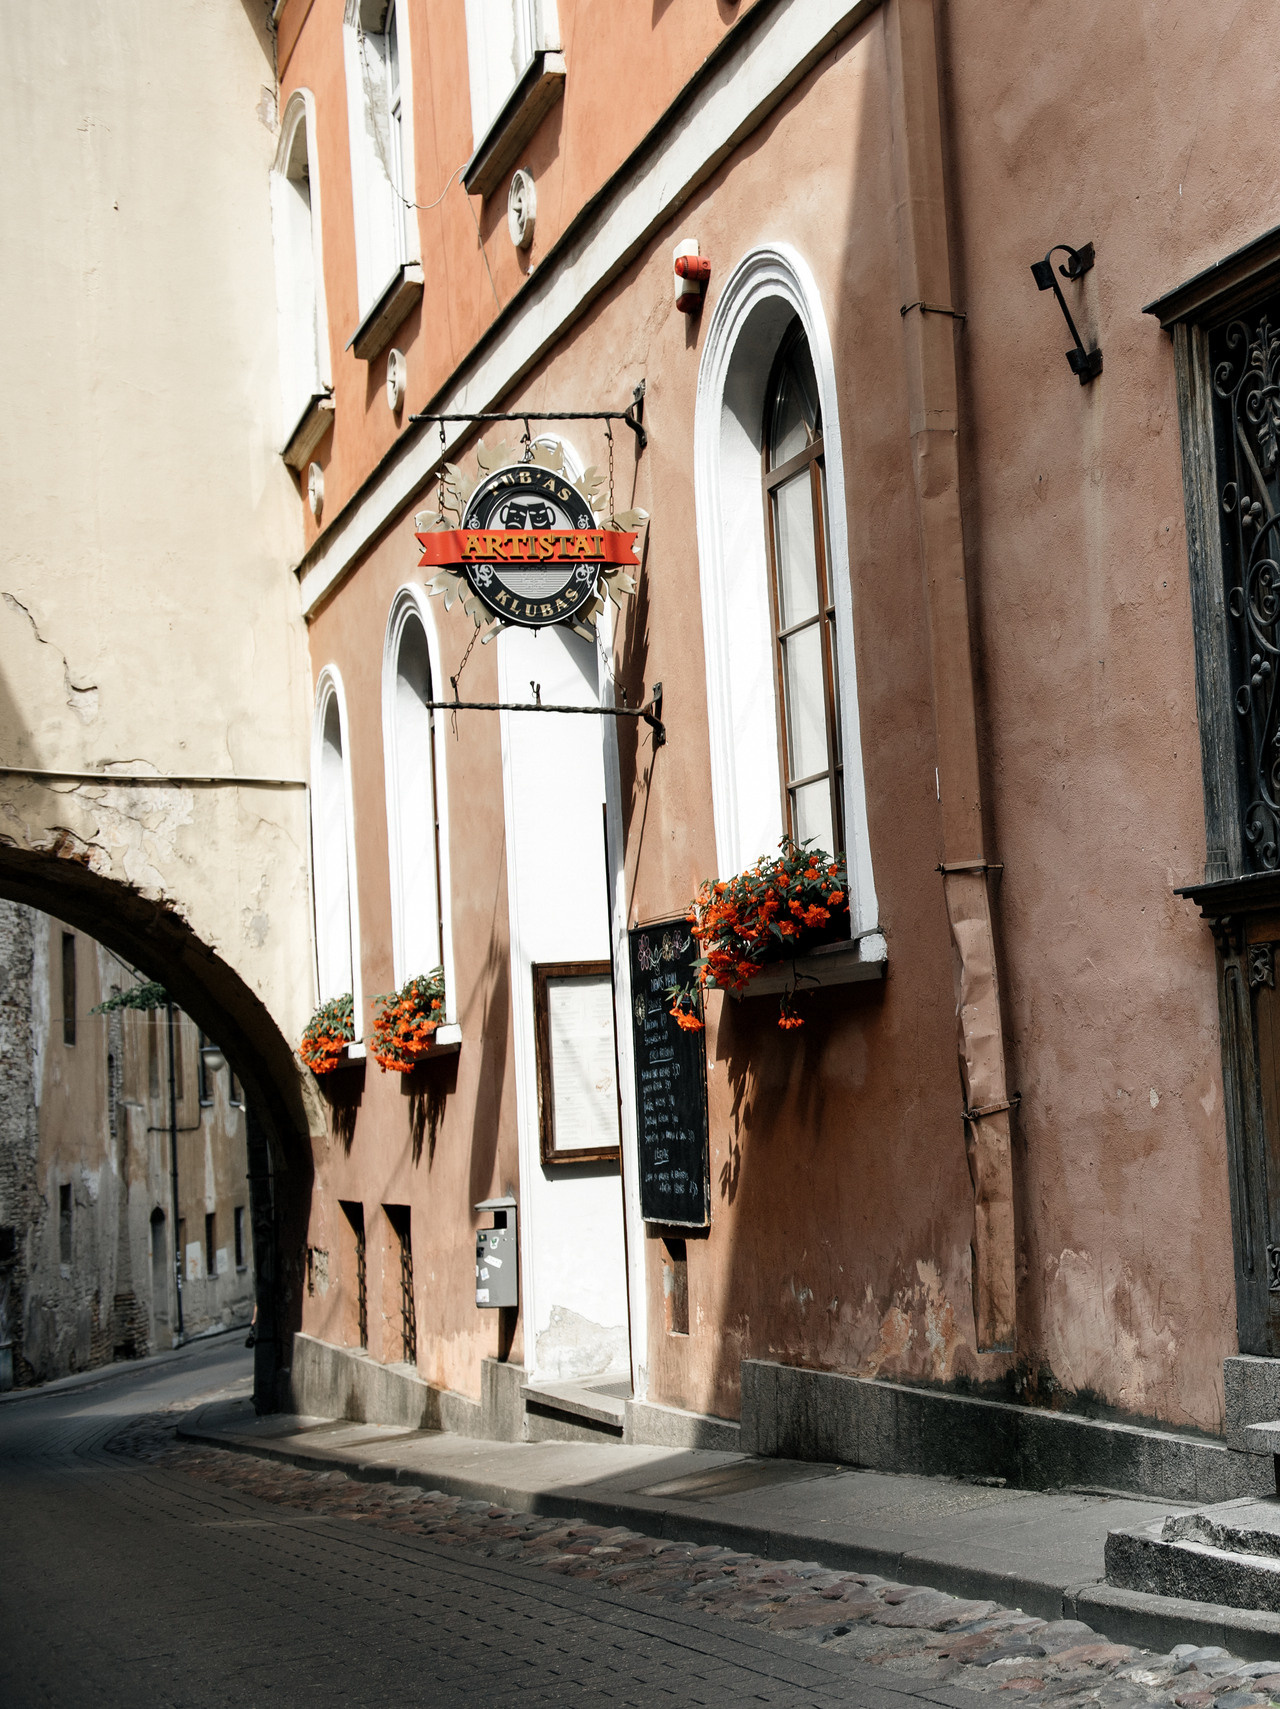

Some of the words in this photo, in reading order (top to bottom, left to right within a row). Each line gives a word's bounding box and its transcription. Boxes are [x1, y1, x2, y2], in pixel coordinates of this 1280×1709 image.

[487, 471, 572, 502] PUB'AS
[462, 534, 605, 560] ARTISTAI
[494, 588, 580, 618] KLUBAS
